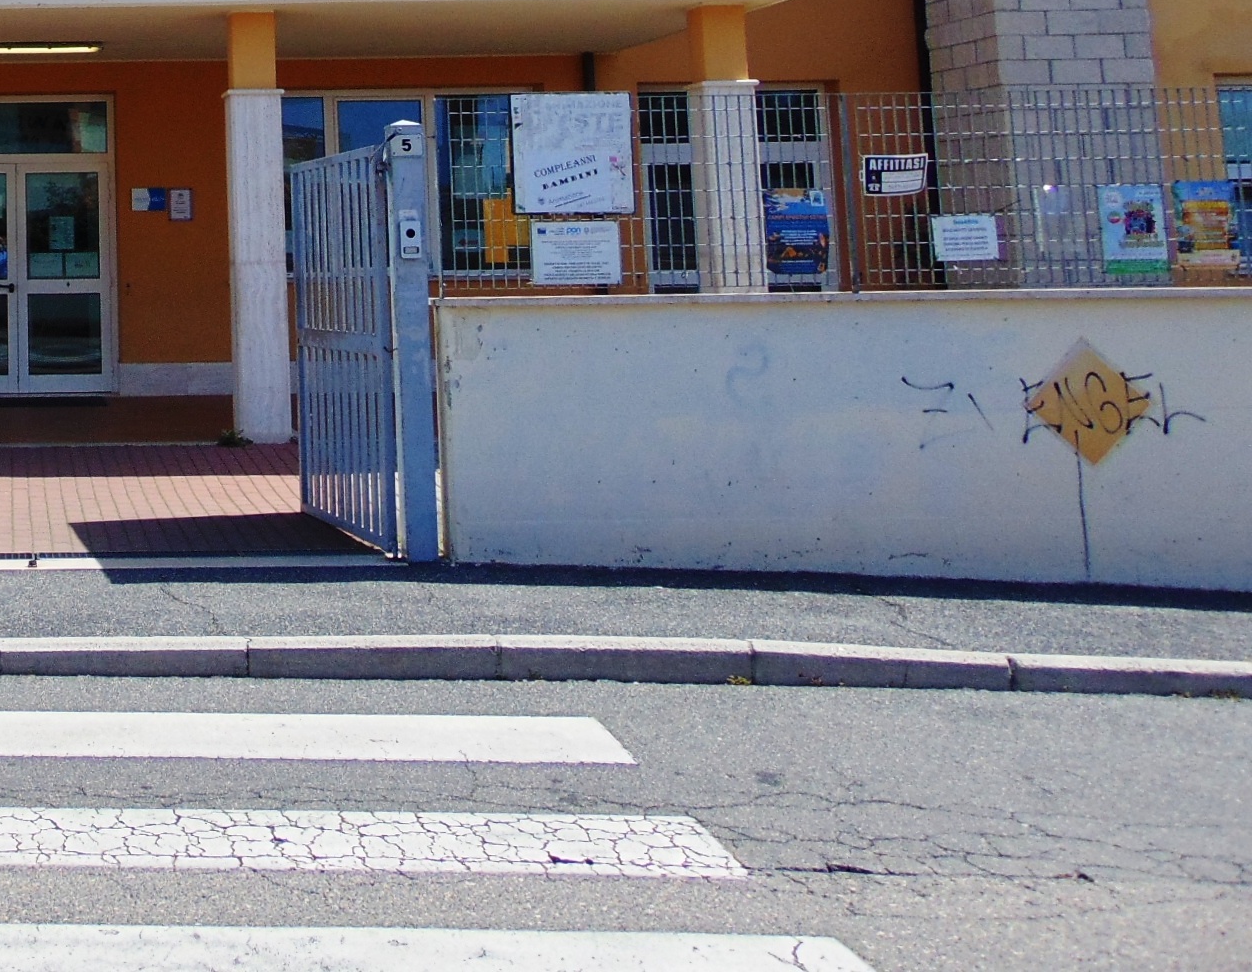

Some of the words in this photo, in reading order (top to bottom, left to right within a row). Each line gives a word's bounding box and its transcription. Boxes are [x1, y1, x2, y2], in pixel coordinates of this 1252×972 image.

[401, 138, 412, 152] 5
[533, 154, 597, 179] COMPLEANNI
[869, 157, 924, 171] AFFITTASI
[542, 168, 598, 191] BAMBINI
